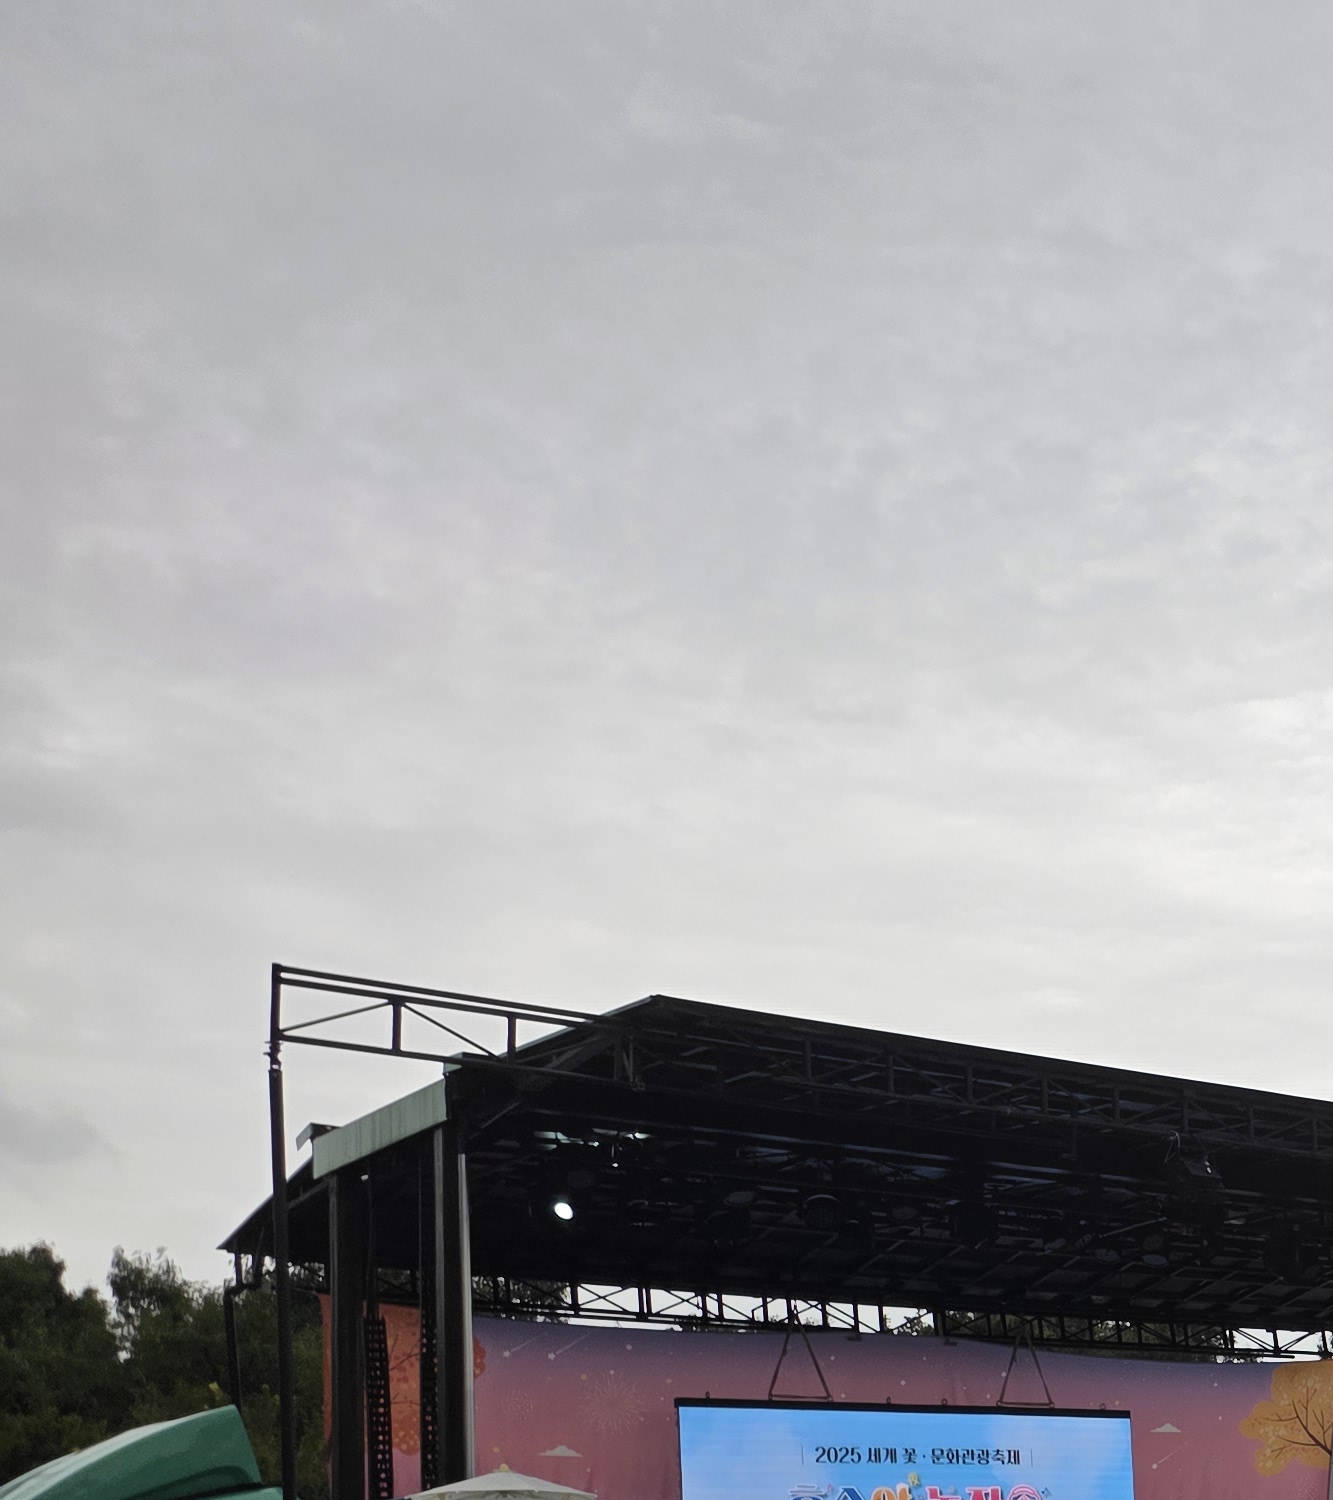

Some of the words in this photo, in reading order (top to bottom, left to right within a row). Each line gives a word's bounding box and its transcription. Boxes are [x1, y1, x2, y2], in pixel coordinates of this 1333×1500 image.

[815, 1447, 862, 1464] 2025
[902, 1447, 918, 1465] 꽃
[930, 1448, 1021, 1466] 문화관광축제
